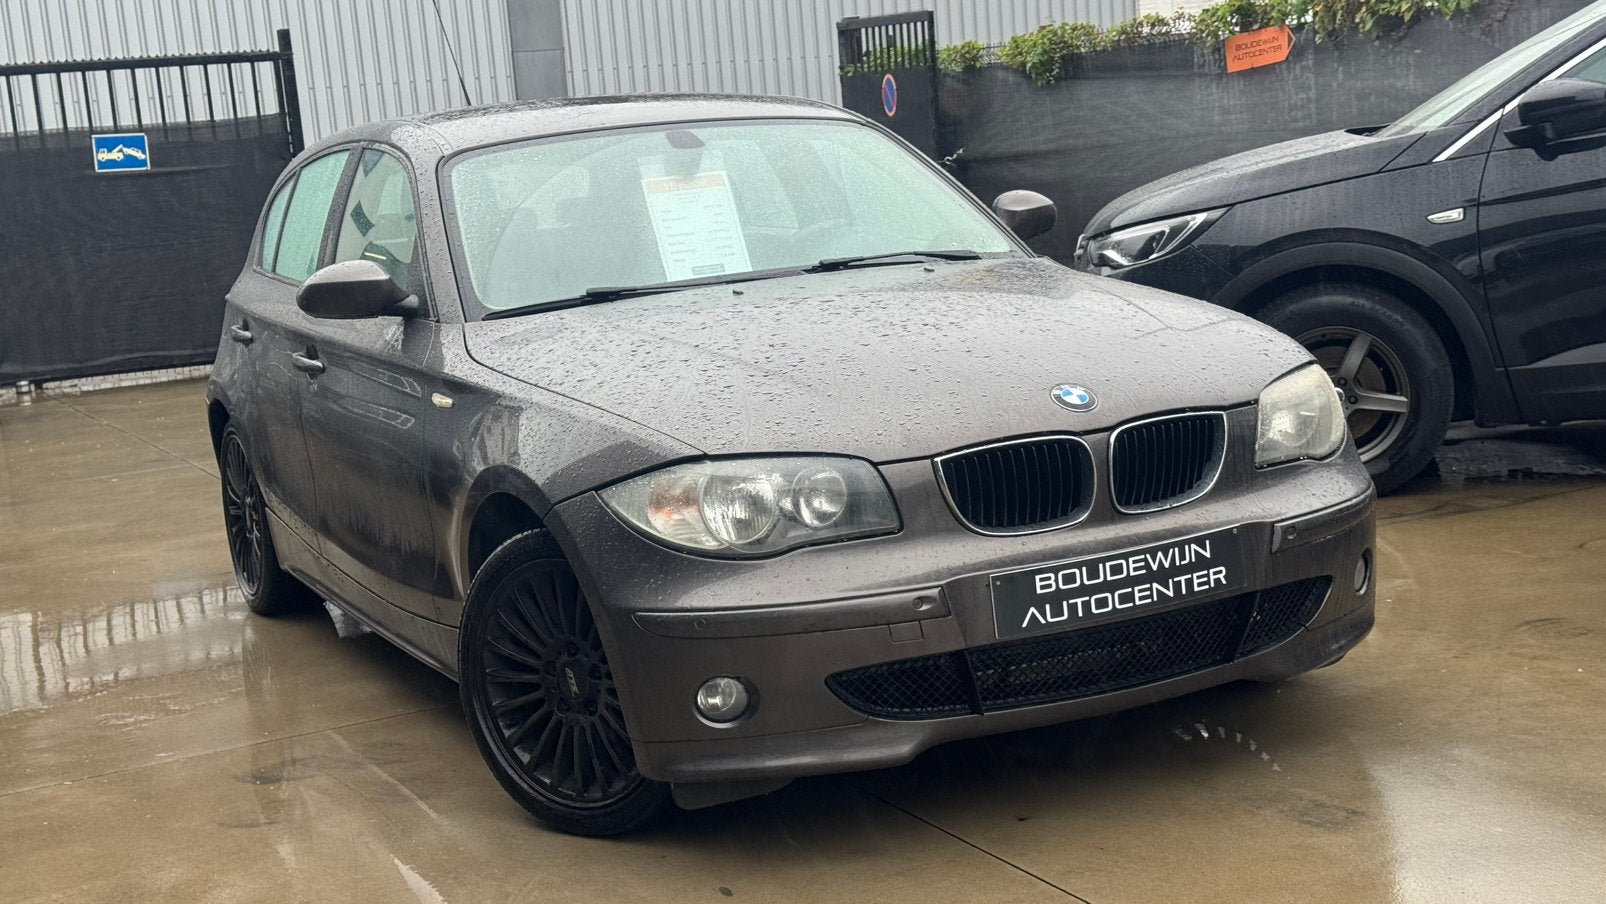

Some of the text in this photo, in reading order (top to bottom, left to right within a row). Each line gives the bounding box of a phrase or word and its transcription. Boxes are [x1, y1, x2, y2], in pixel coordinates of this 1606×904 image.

[1232, 44, 1283, 63] AUTOCENTER
[1234, 36, 1280, 52] BOUDEWIJN
[1034, 539, 1212, 595] BOUDEWIJN
[1021, 565, 1228, 628] AUTOCENTER
